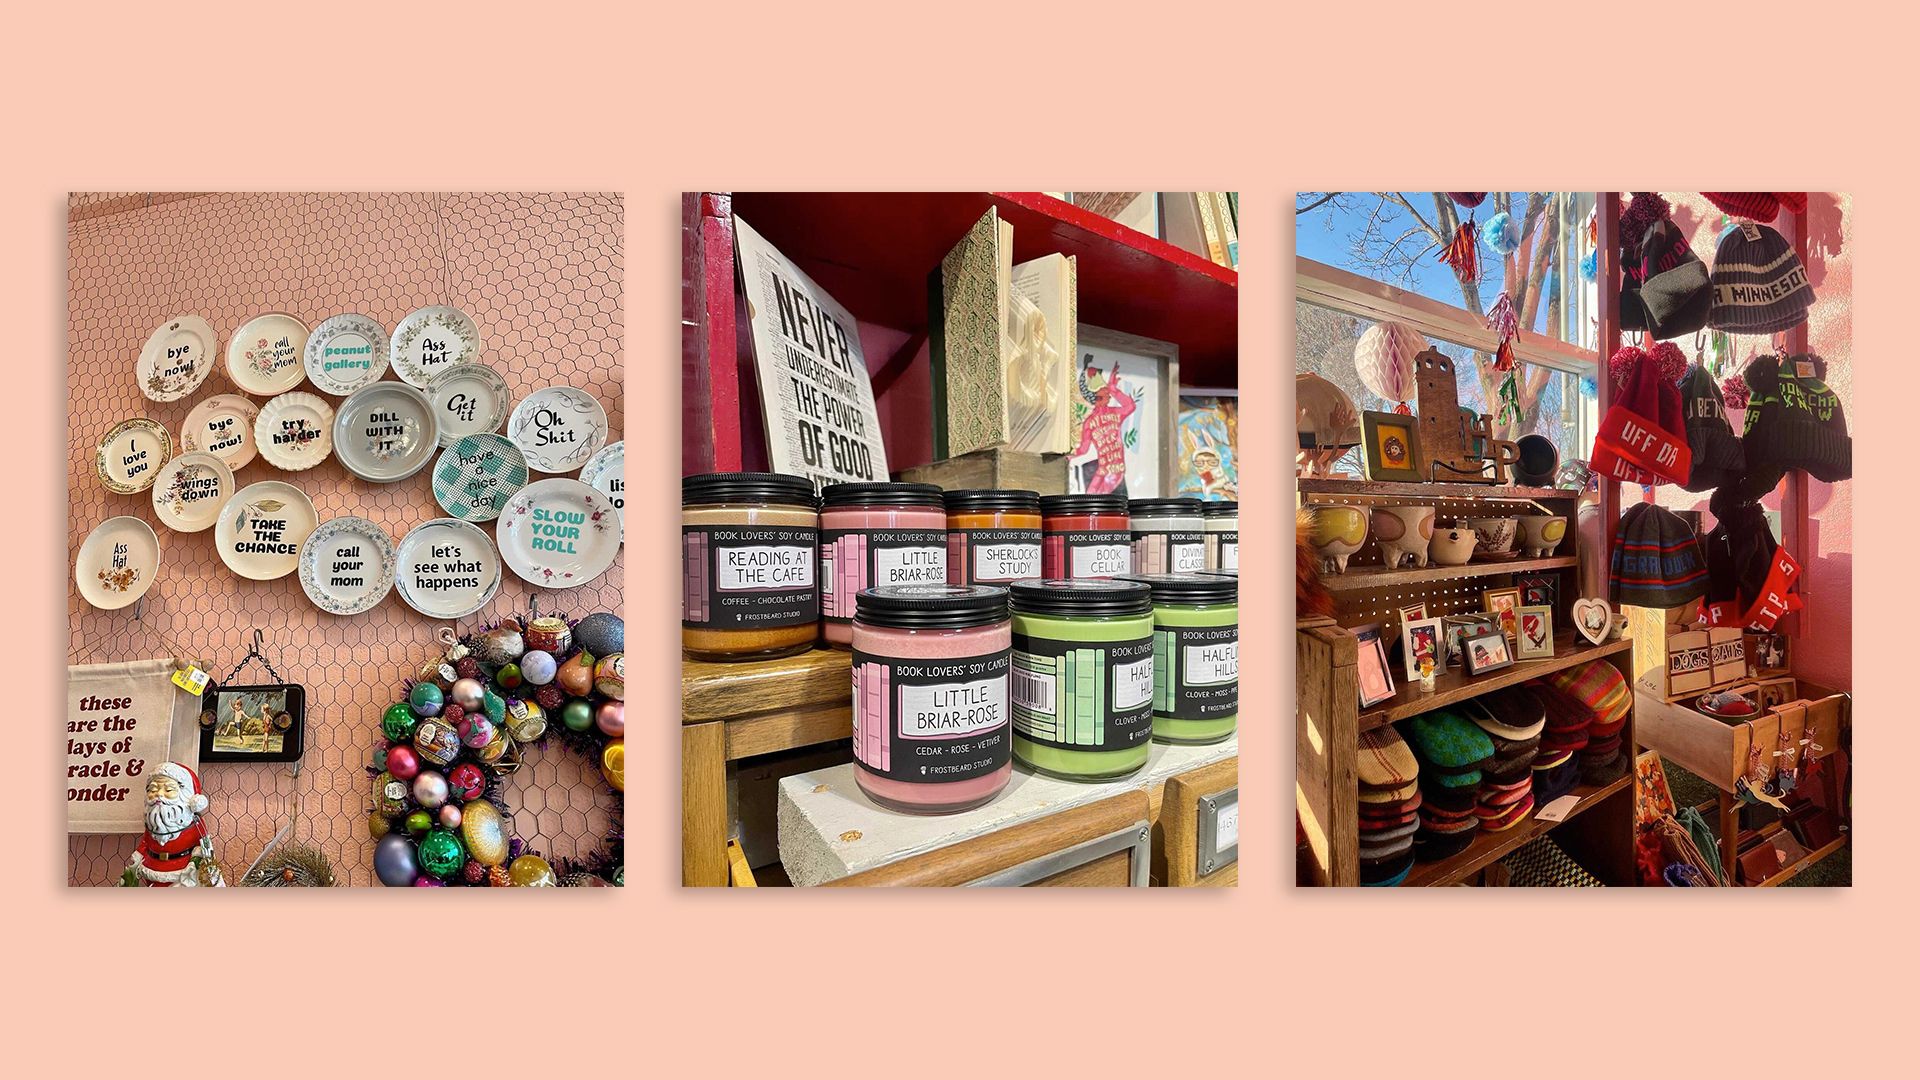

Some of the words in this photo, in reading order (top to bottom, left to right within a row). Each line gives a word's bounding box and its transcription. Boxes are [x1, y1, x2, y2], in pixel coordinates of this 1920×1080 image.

[772, 272, 854, 378] NEVER
[274, 336, 290, 349] call
[423, 339, 445, 351] Ass
[168, 345, 190, 359] bye
[272, 347, 295, 360] your
[325, 345, 371, 358] peanut
[423, 351, 451, 365] Hat
[165, 360, 194, 377] now!
[273, 356, 297, 369] mom
[325, 359, 370, 372] gallery
[786, 344, 860, 405] UNDERESTIMATE
[447, 394, 476, 414] Get
[791, 377, 822, 420] THE
[823, 393, 866, 440] POWER
[370, 413, 399, 423] DILL
[461, 410, 474, 422] it
[535, 410, 565, 428] Oh
[209, 418, 233, 431] bye
[282, 419, 304, 430] try
[366, 425, 404, 436] WITH
[273, 429, 321, 444] harder
[536, 427, 575, 446] Shit
[131, 440, 135, 452] I
[210, 436, 242, 452] now!
[379, 441, 392, 450] IT
[799, 419, 825, 468] OF
[829, 431, 873, 481] GOOD
[1621, 421, 1656, 451] UFF
[1656, 441, 1678, 467] DA
[123, 450, 147, 465] love
[459, 449, 494, 466] have
[127, 462, 148, 478] you
[476, 466, 484, 475] a
[182, 477, 218, 490] wings
[469, 476, 497, 490] nice
[182, 488, 218, 501] down
[471, 494, 496, 512] day
[533, 509, 584, 523] SLOW
[250, 520, 286, 530] TAKE
[254, 531, 280, 542] THE
[531, 524, 580, 540] YOUR
[715, 532, 737, 540] BOOK
[741, 531, 776, 540] LOVERS'
[779, 532, 793, 540] SOY
[795, 533, 814, 541] CANDLE
[874, 533, 894, 542] BOOK
[897, 533, 926, 542] LOVERS'
[927, 533, 937, 541] SOY
[973, 532, 991, 540] BOOK
[1070, 534, 1087, 542] BOOK
[114, 543, 127, 555] Ass
[235, 543, 296, 554] CHANCE
[337, 546, 360, 558] call
[432, 546, 460, 558] let's
[532, 538, 577, 554] ROLL
[113, 555, 127, 567] Hat
[729, 551, 790, 566] READING
[795, 551, 807, 564] AT
[902, 552, 938, 565] LITTLE
[987, 549, 1039, 560] SHERLOCK'S
[1097, 549, 1122, 560] BOOK
[332, 560, 363, 573] your
[414, 563, 441, 573] see
[444, 561, 482, 573] what
[999, 562, 1031, 574] STUDY
[1091, 562, 1126, 574] CELLAR
[736, 569, 766, 583] THE
[774, 567, 805, 581] CAFE
[890, 567, 943, 581] BRIAR-ROSE
[331, 576, 363, 586] mom
[416, 576, 478, 591] happens
[722, 597, 749, 605] COFFEE
[758, 596, 795, 604] CHOCOLATE
[797, 594, 812, 603] PASTRY
[783, 611, 800, 619] STUDIO
[1183, 632, 1204, 640] BOOK
[1112, 647, 1132, 657] BOOK
[1672, 651, 1709, 670] DOGS
[897, 666, 922, 677] BOOK
[927, 666, 967, 677] LOVERS'
[970, 663, 986, 675] SOY
[988, 658, 1008, 672] CANDLE
[934, 686, 988, 708] LITTLE
[1215, 689, 1228, 697] MOSS
[80, 696, 132, 711] these
[103, 715, 136, 731] the
[917, 703, 998, 730] BRIAR-ROSE
[1115, 716, 1137, 726] CLOVER
[112, 737, 132, 754] of
[916, 746, 942, 756] CEDAR
[951, 744, 969, 753] ROSE
[978, 735, 1000, 751] VETIVER
[126, 759, 144, 776] &
[931, 764, 972, 774] FROSTBEARD
[973, 758, 993, 770] STUDIO
